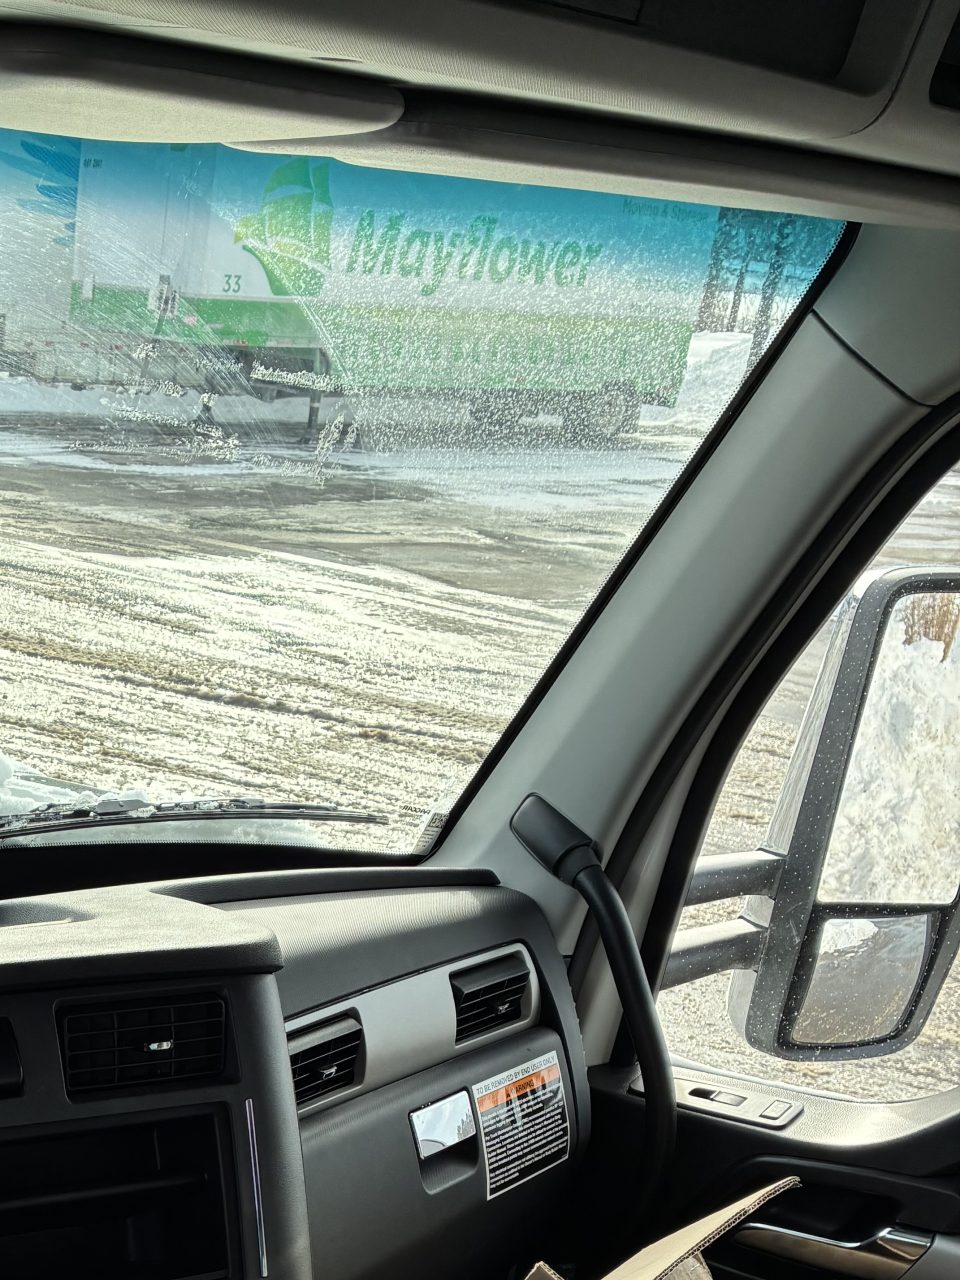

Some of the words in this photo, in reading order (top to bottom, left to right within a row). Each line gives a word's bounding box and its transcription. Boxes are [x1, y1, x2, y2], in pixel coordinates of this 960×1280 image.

[348, 208, 603, 296] Mayflower
[222, 274, 242, 293] 33
[490, 1075, 514, 1090] REMOVED
[521, 1066, 531, 1076] END
